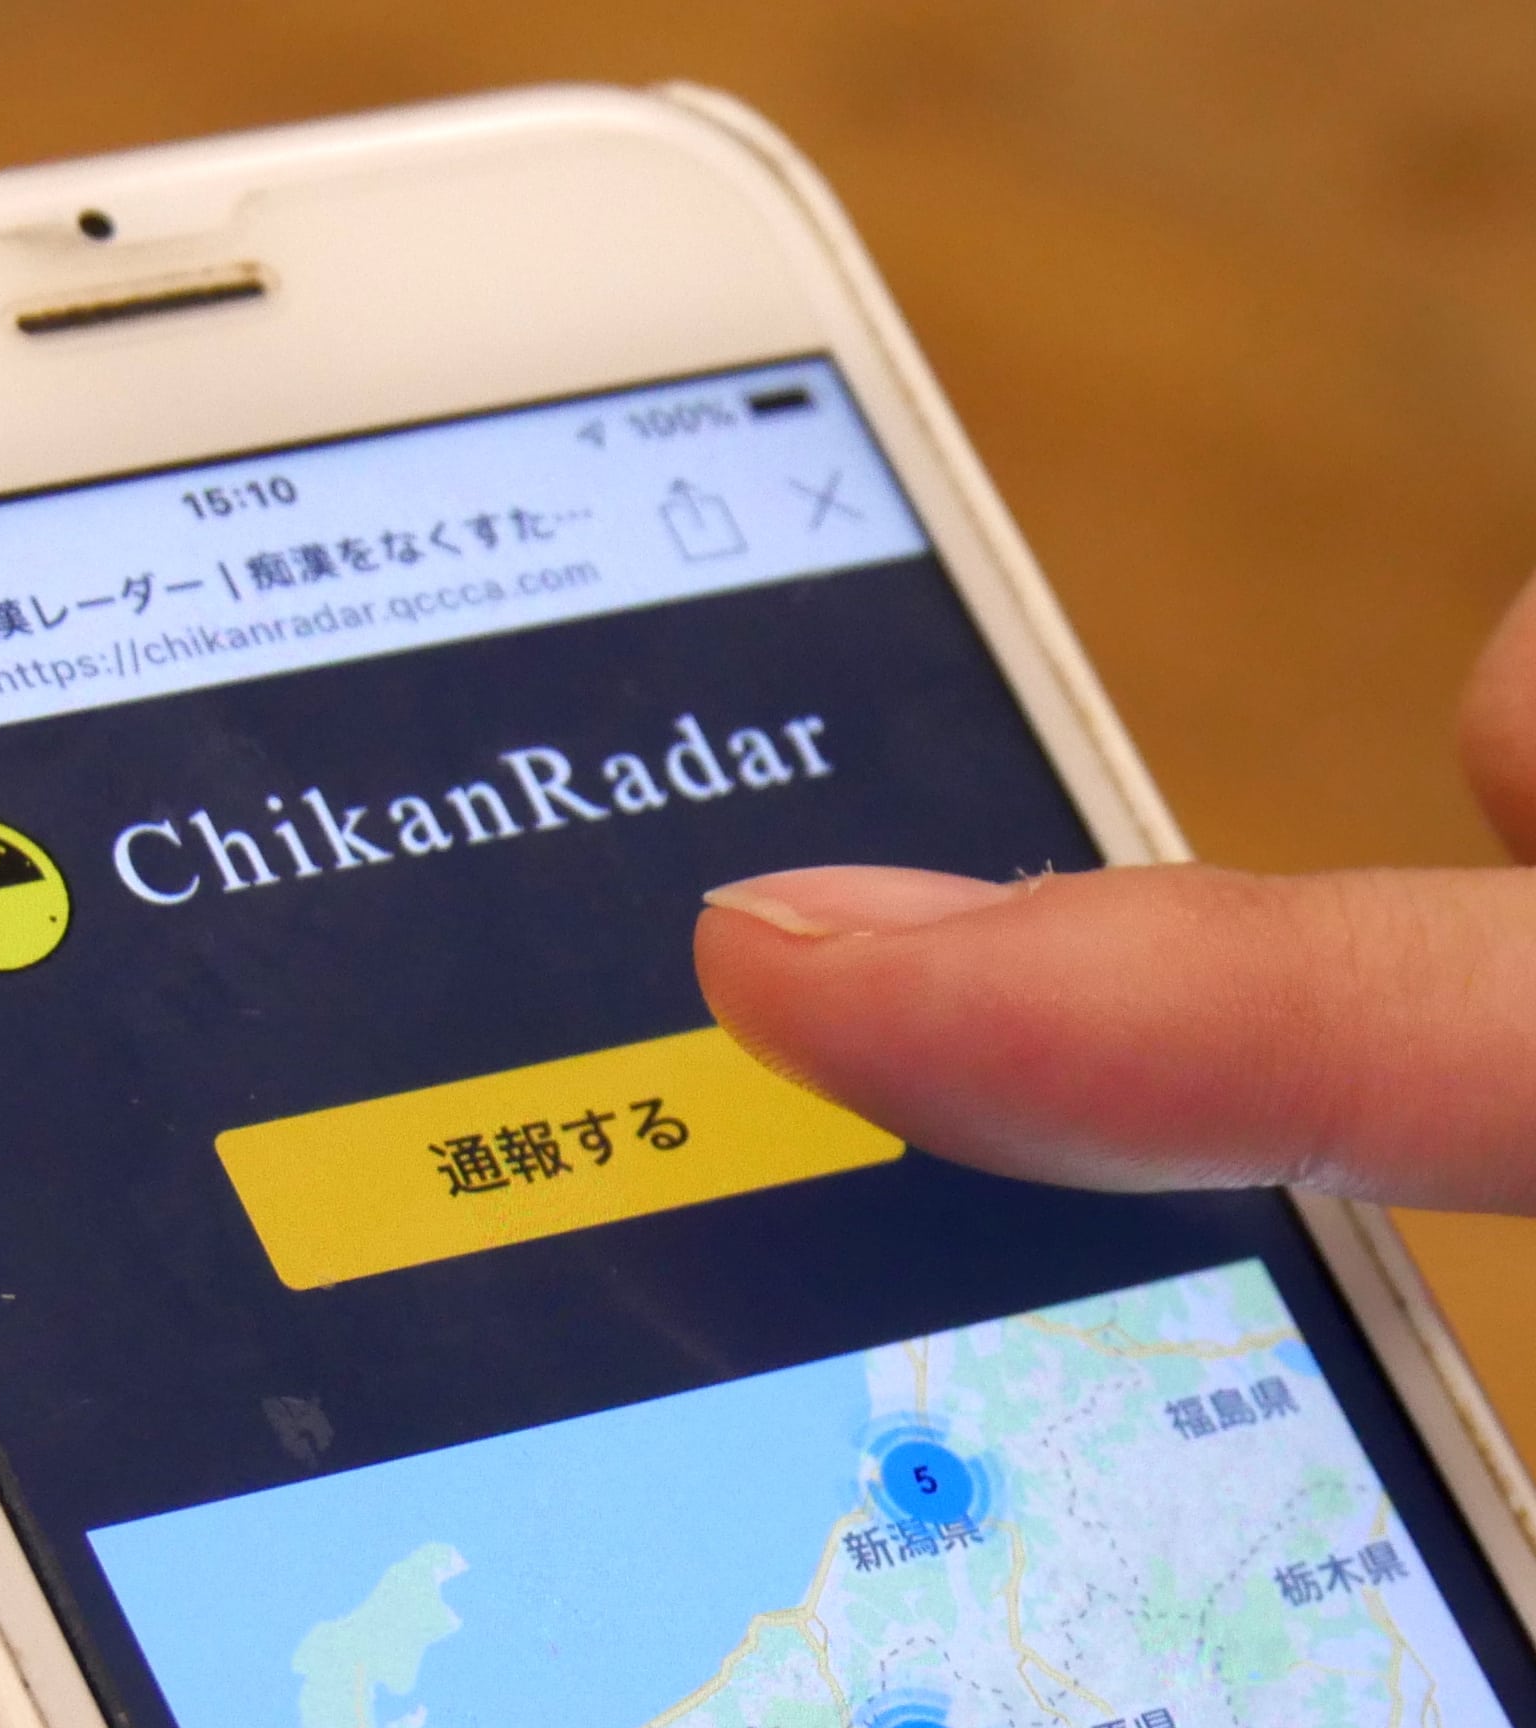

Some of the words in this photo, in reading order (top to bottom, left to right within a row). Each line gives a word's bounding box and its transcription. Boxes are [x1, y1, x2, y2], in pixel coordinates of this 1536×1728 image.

[182, 475, 298, 520] 15:10
[109, 713, 834, 906] ChikanRadar
[428, 1096, 692, 1201] 通報する
[1165, 1374, 1301, 1442] 福島県
[912, 1464, 939, 1495] 5
[1273, 1539, 1410, 1608] 栃木県
